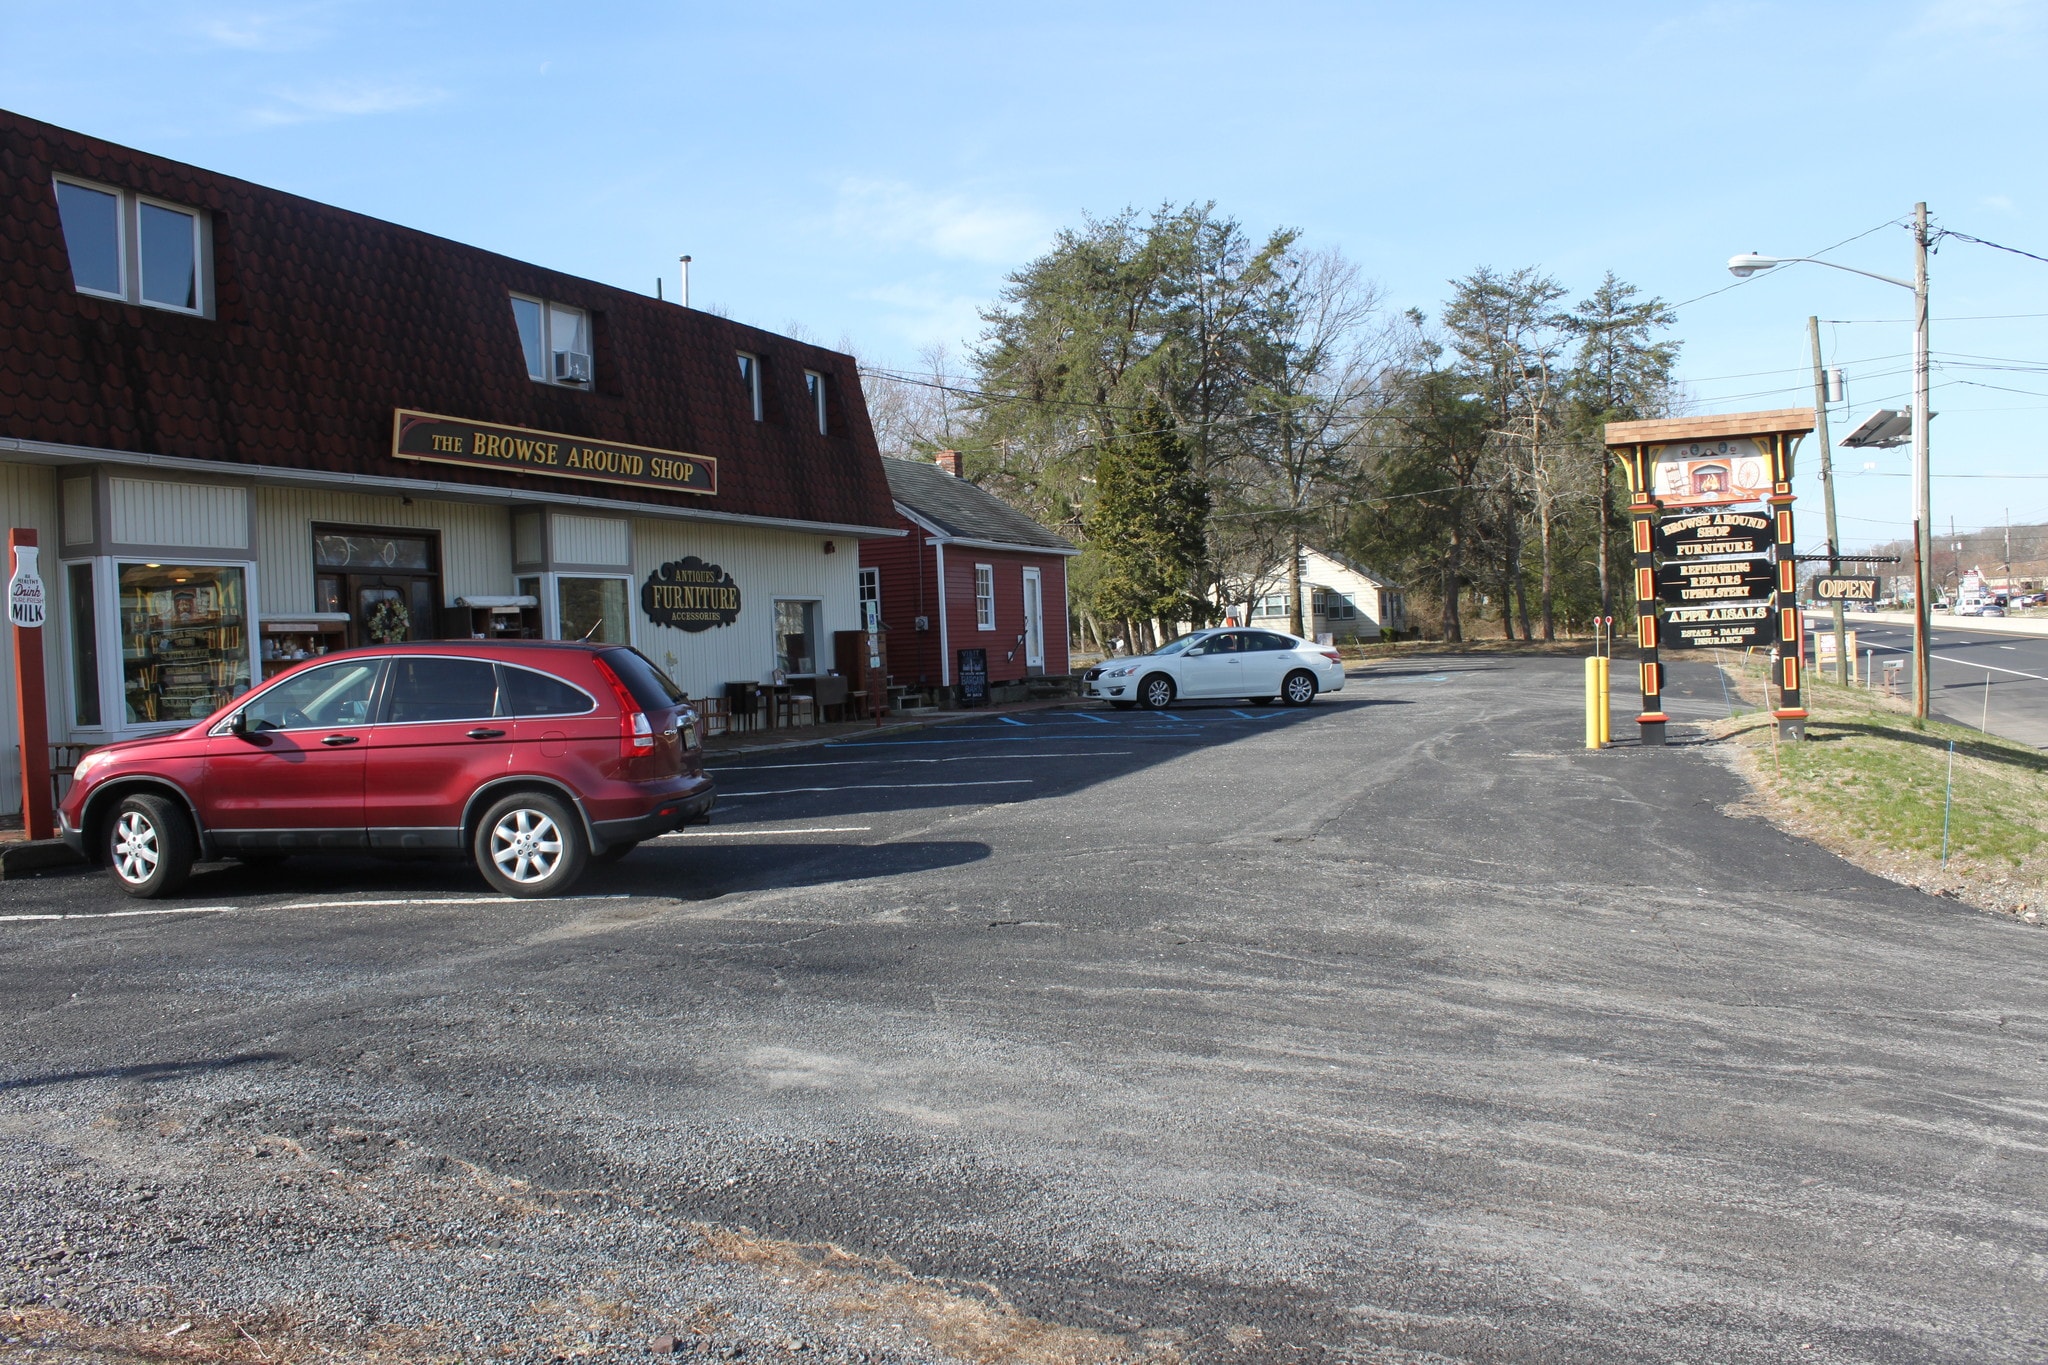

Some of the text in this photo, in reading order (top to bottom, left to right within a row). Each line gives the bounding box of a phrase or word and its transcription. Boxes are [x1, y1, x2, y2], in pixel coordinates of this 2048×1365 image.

[432, 432, 694, 482] THE BROWSE AROUND SHOP
[1661, 514, 1767, 536] BROWSE AROUND
[1697, 526, 1731, 538] SHOP
[1676, 541, 1753, 556] FURNITURE
[675, 569, 715, 583] ANTIQUES
[1680, 562, 1751, 576] REFINISHING
[1690, 575, 1742, 587] REPAIRS
[13, 584, 42, 597] Drink
[1681, 586, 1751, 599] UPHOLSTERY
[1818, 579, 1875, 599] OPEN
[652, 585, 737, 610] FURNITURE
[12, 603, 44, 622] MILK
[671, 612, 721, 621] ACCESSORIES
[1668, 607, 1767, 623] APPRAISALS
[1680, 627, 1756, 638] ESTATE DAMAGE
[1693, 636, 1743, 645] INSURANCE
